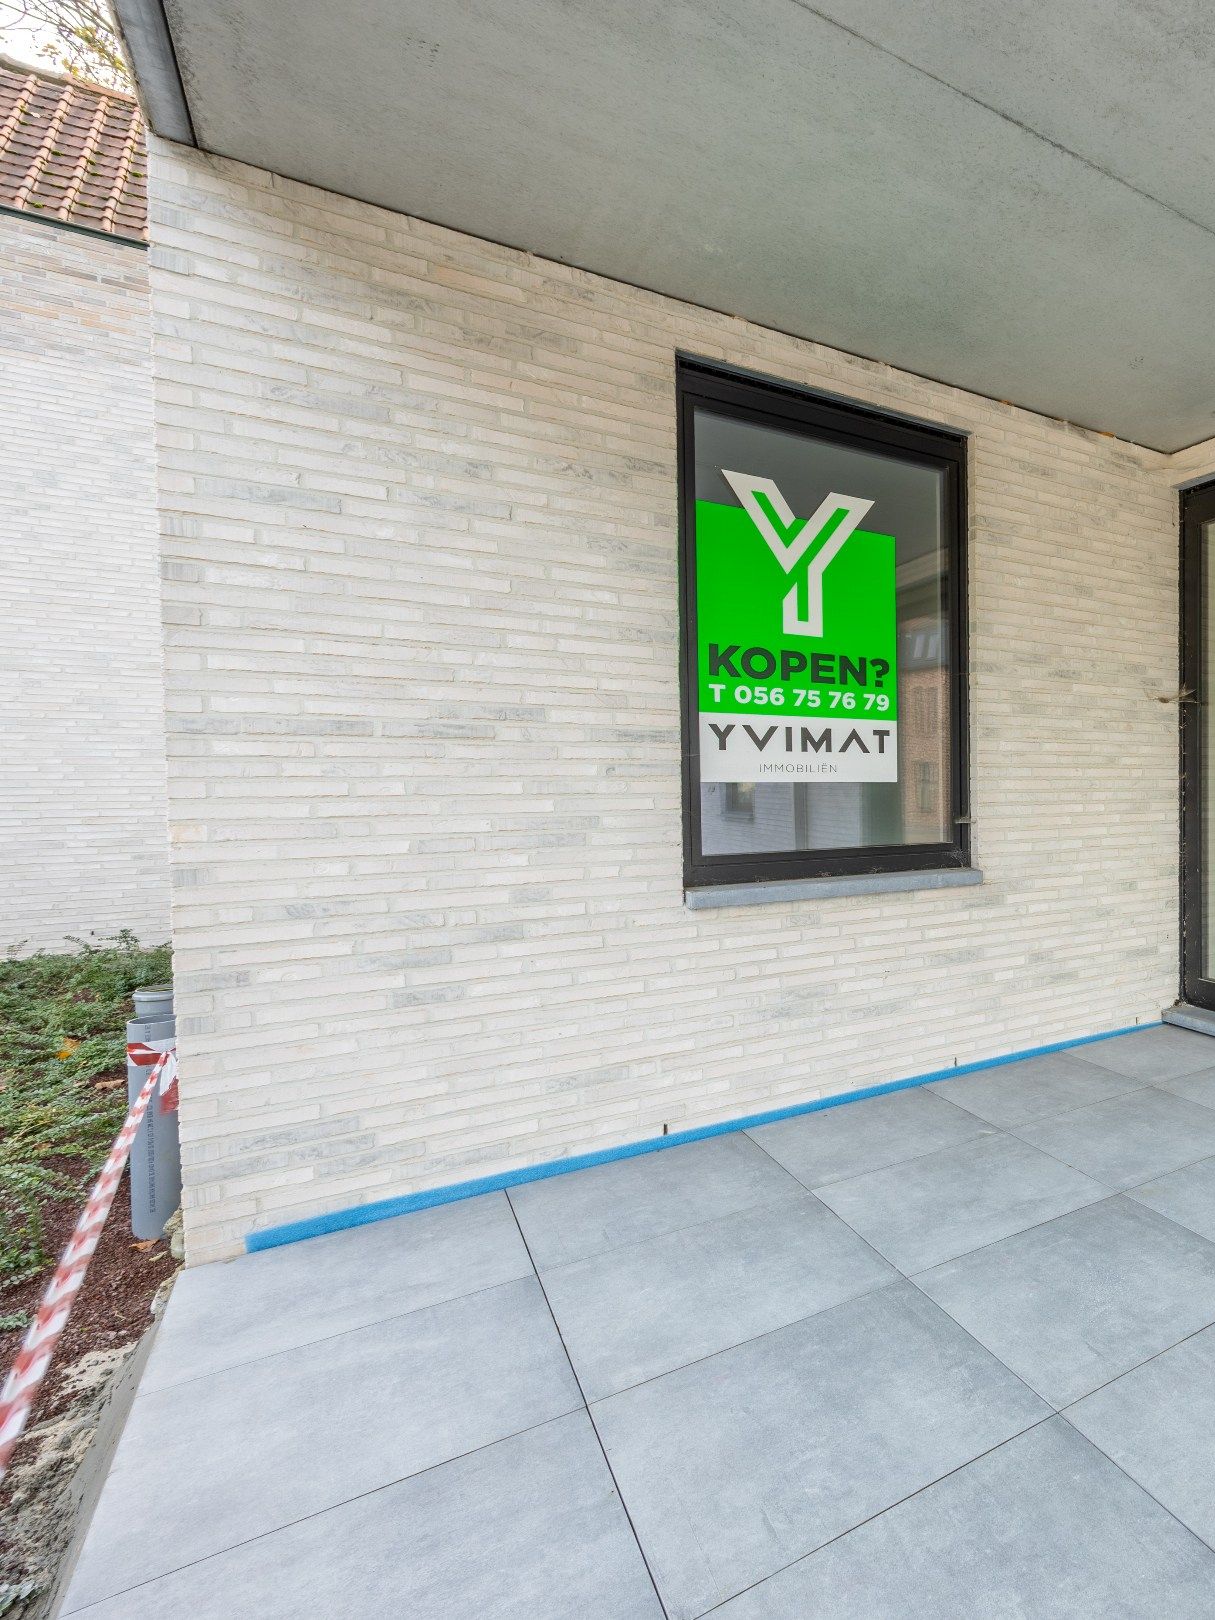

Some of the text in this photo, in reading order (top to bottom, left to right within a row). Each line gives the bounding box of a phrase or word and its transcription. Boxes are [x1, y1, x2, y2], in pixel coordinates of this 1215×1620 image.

[708, 642, 890, 688] KOPEN?
[708, 683, 890, 712] T 056 75 76 79
[708, 723, 891, 754] YVIMAT
[758, 763, 837, 774] IMMOBILIËN
